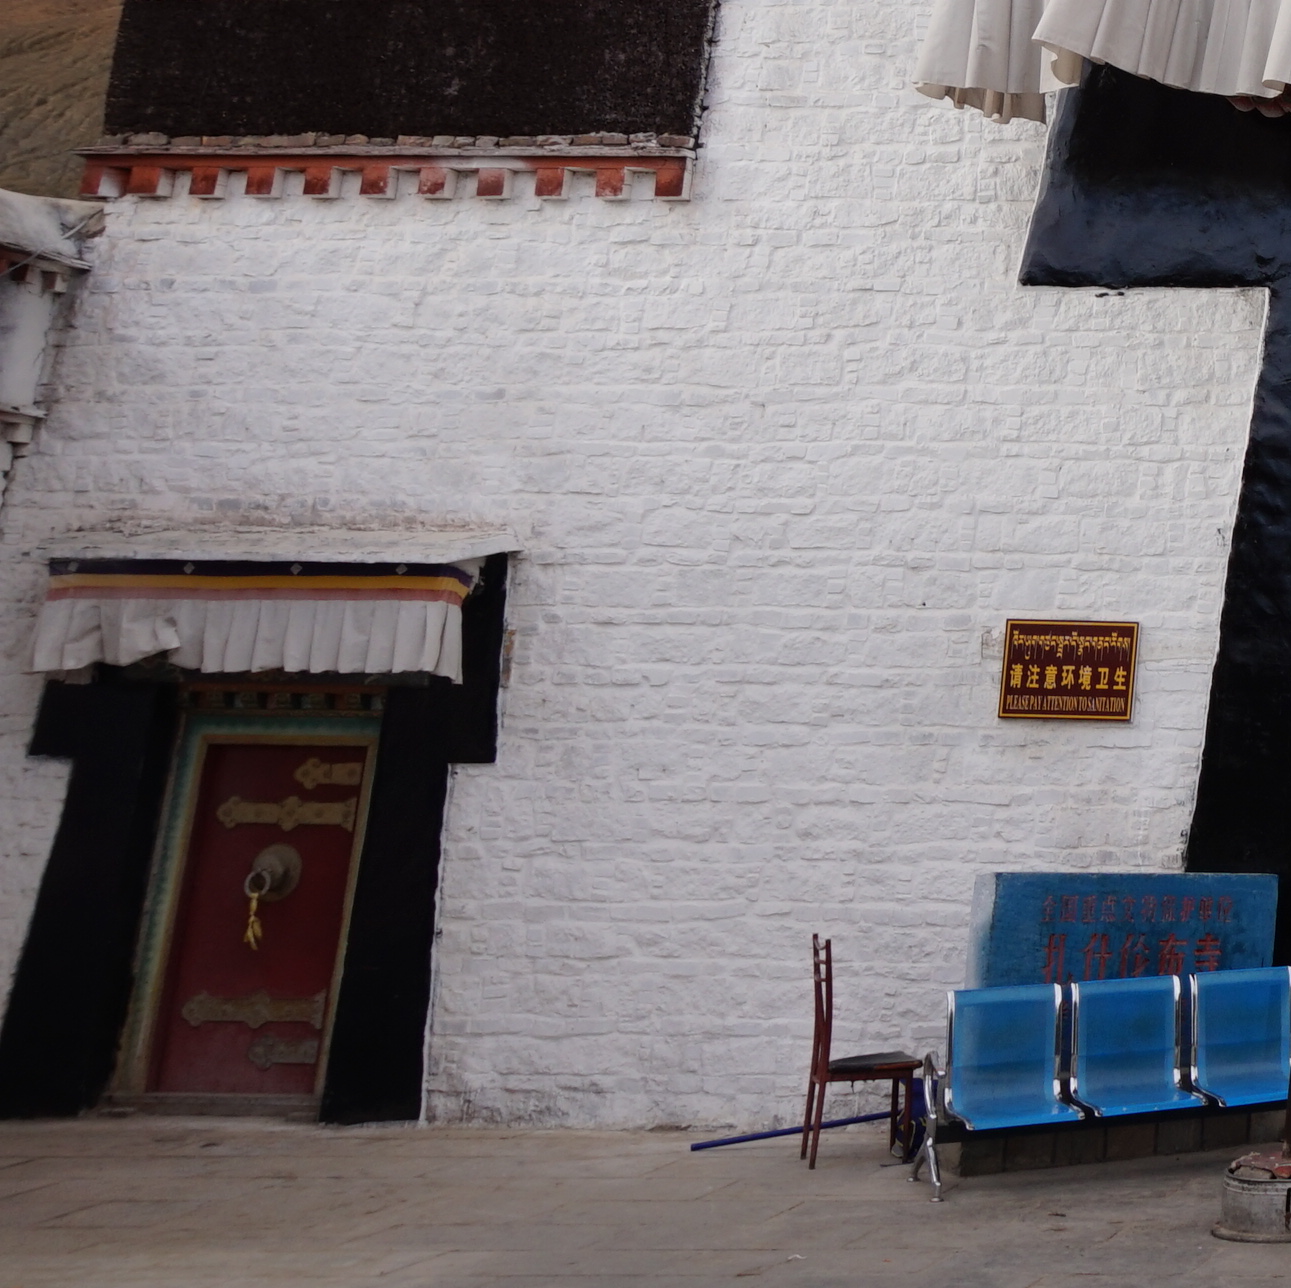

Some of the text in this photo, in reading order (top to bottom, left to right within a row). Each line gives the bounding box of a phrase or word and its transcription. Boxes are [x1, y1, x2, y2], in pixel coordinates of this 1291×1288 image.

[1010, 663, 1127, 690] 请注意环境卫生
[1006, 695, 1125, 712] PLEASE PAY ATTENTION TO SANITATION
[1042, 933, 1222, 983] 扎什伦布寺
